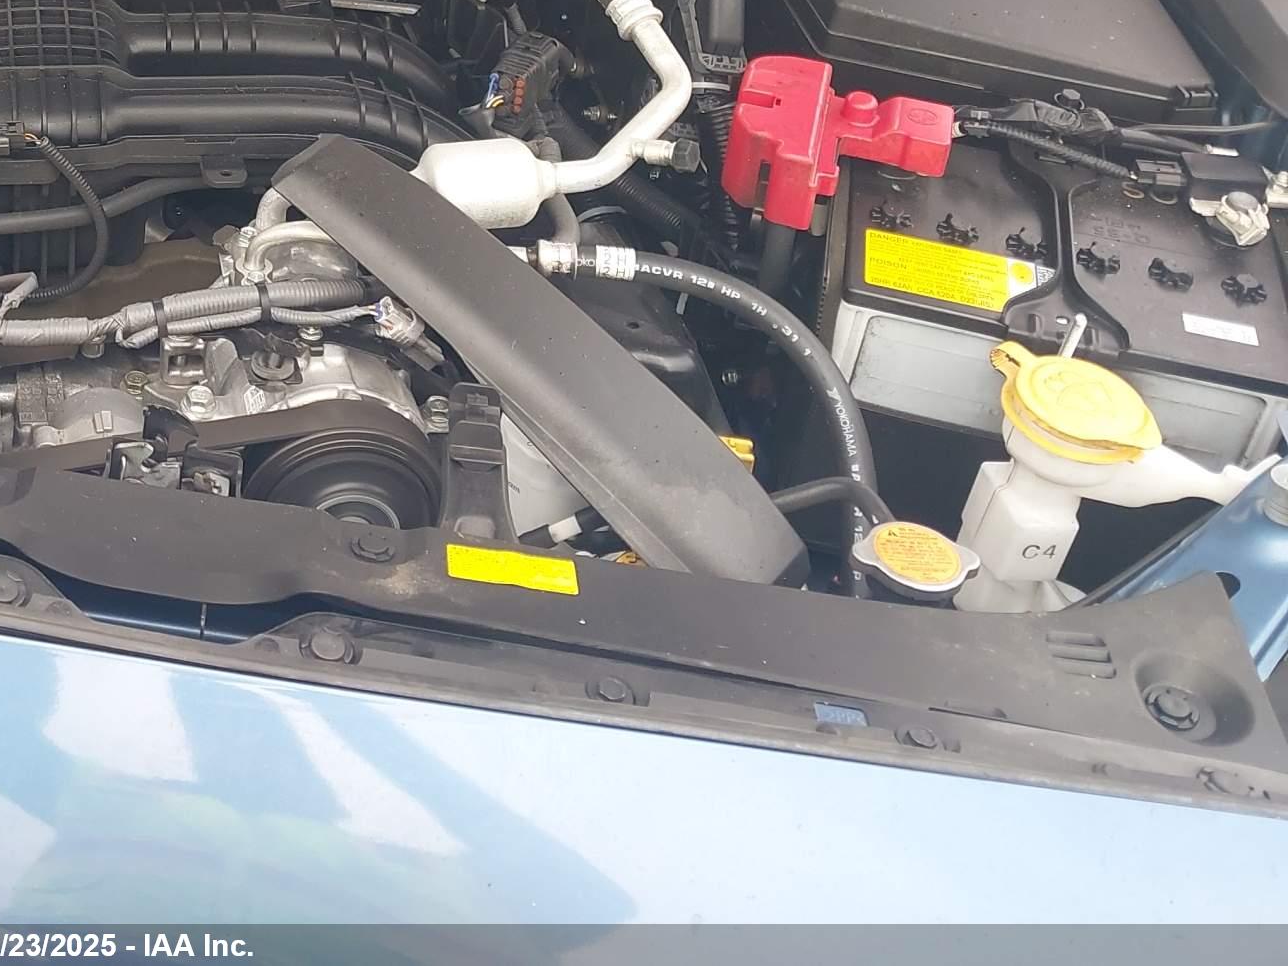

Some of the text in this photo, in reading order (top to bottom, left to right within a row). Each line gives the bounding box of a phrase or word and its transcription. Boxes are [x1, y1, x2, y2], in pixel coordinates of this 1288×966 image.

[869, 232, 909, 245] DANGER
[869, 257, 907, 270] POISON
[721, 286, 741, 299] HP
[834, 401, 857, 457] YOKOHAMA
[1022, 544, 1057, 560] C4
